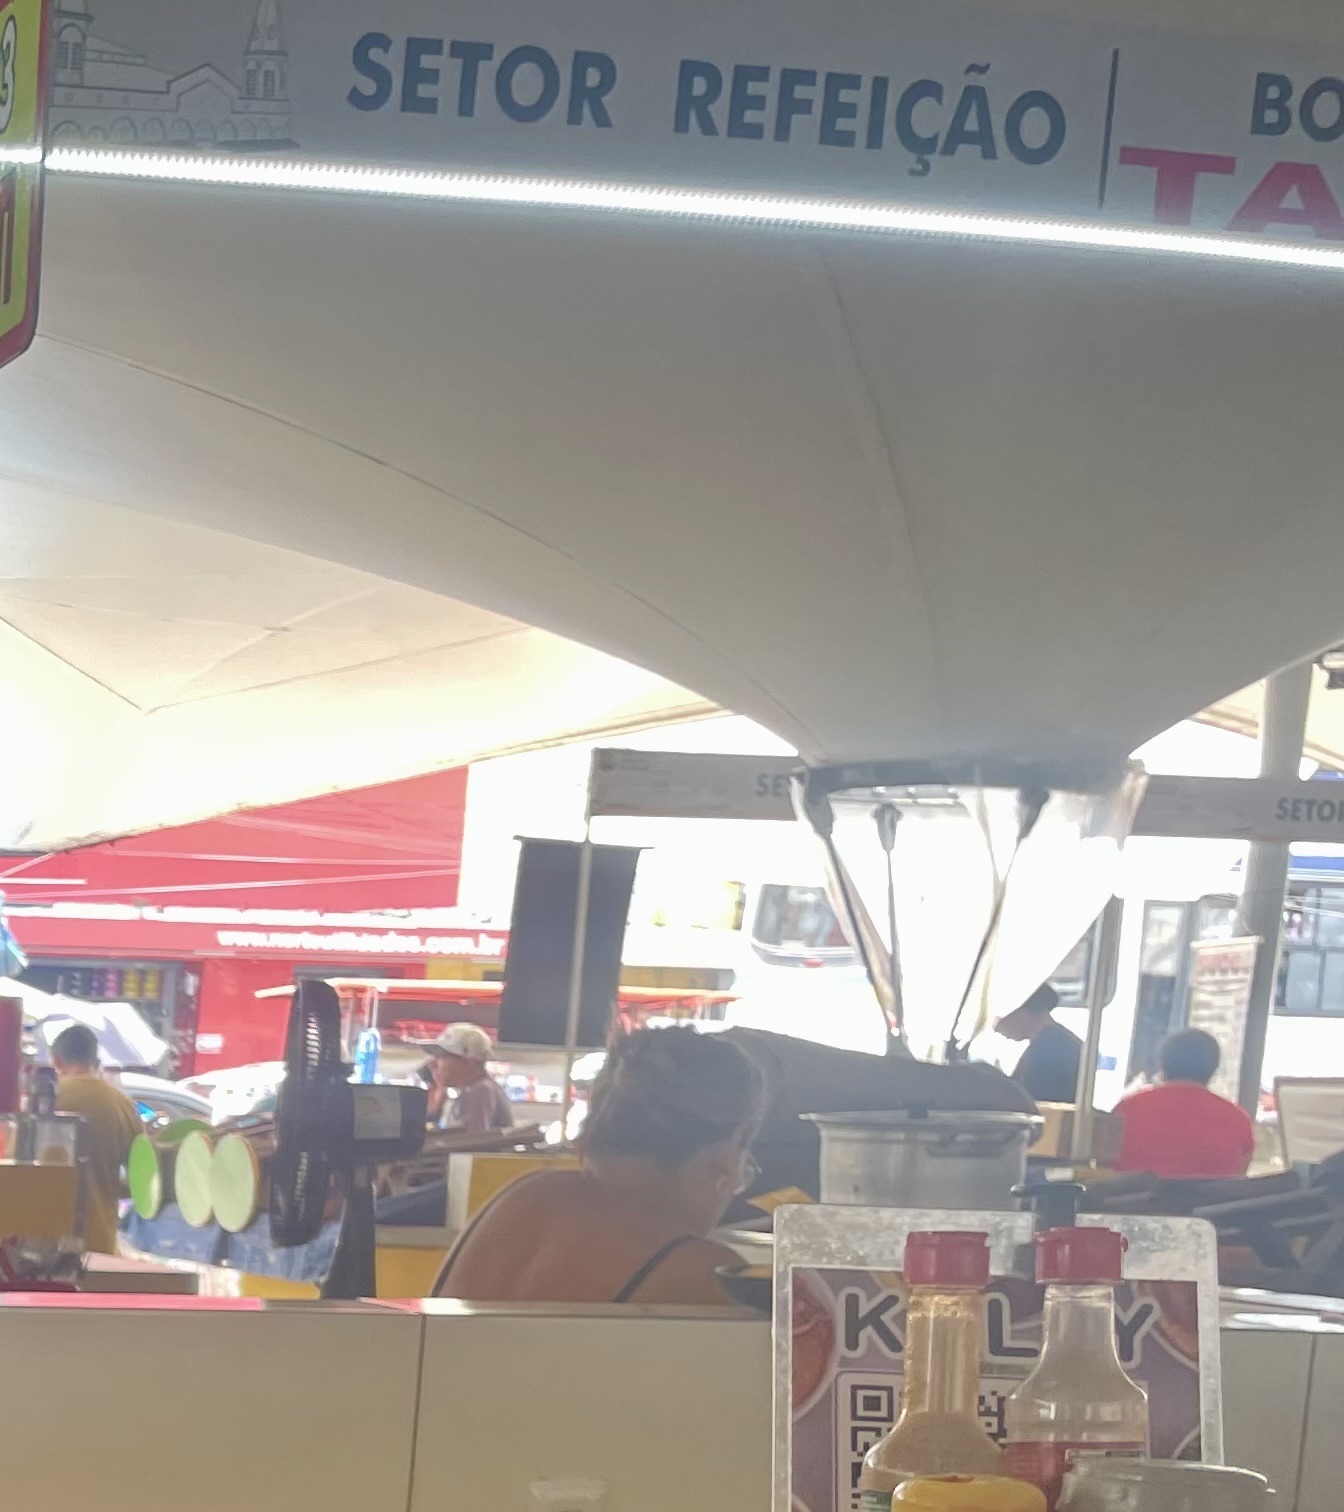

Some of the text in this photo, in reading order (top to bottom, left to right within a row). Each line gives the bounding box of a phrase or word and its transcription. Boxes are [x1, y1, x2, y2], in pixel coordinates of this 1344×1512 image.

[347, 31, 1067, 176] SETOR REFEIÇÃO
[844, 1290, 1156, 1363] KLY
